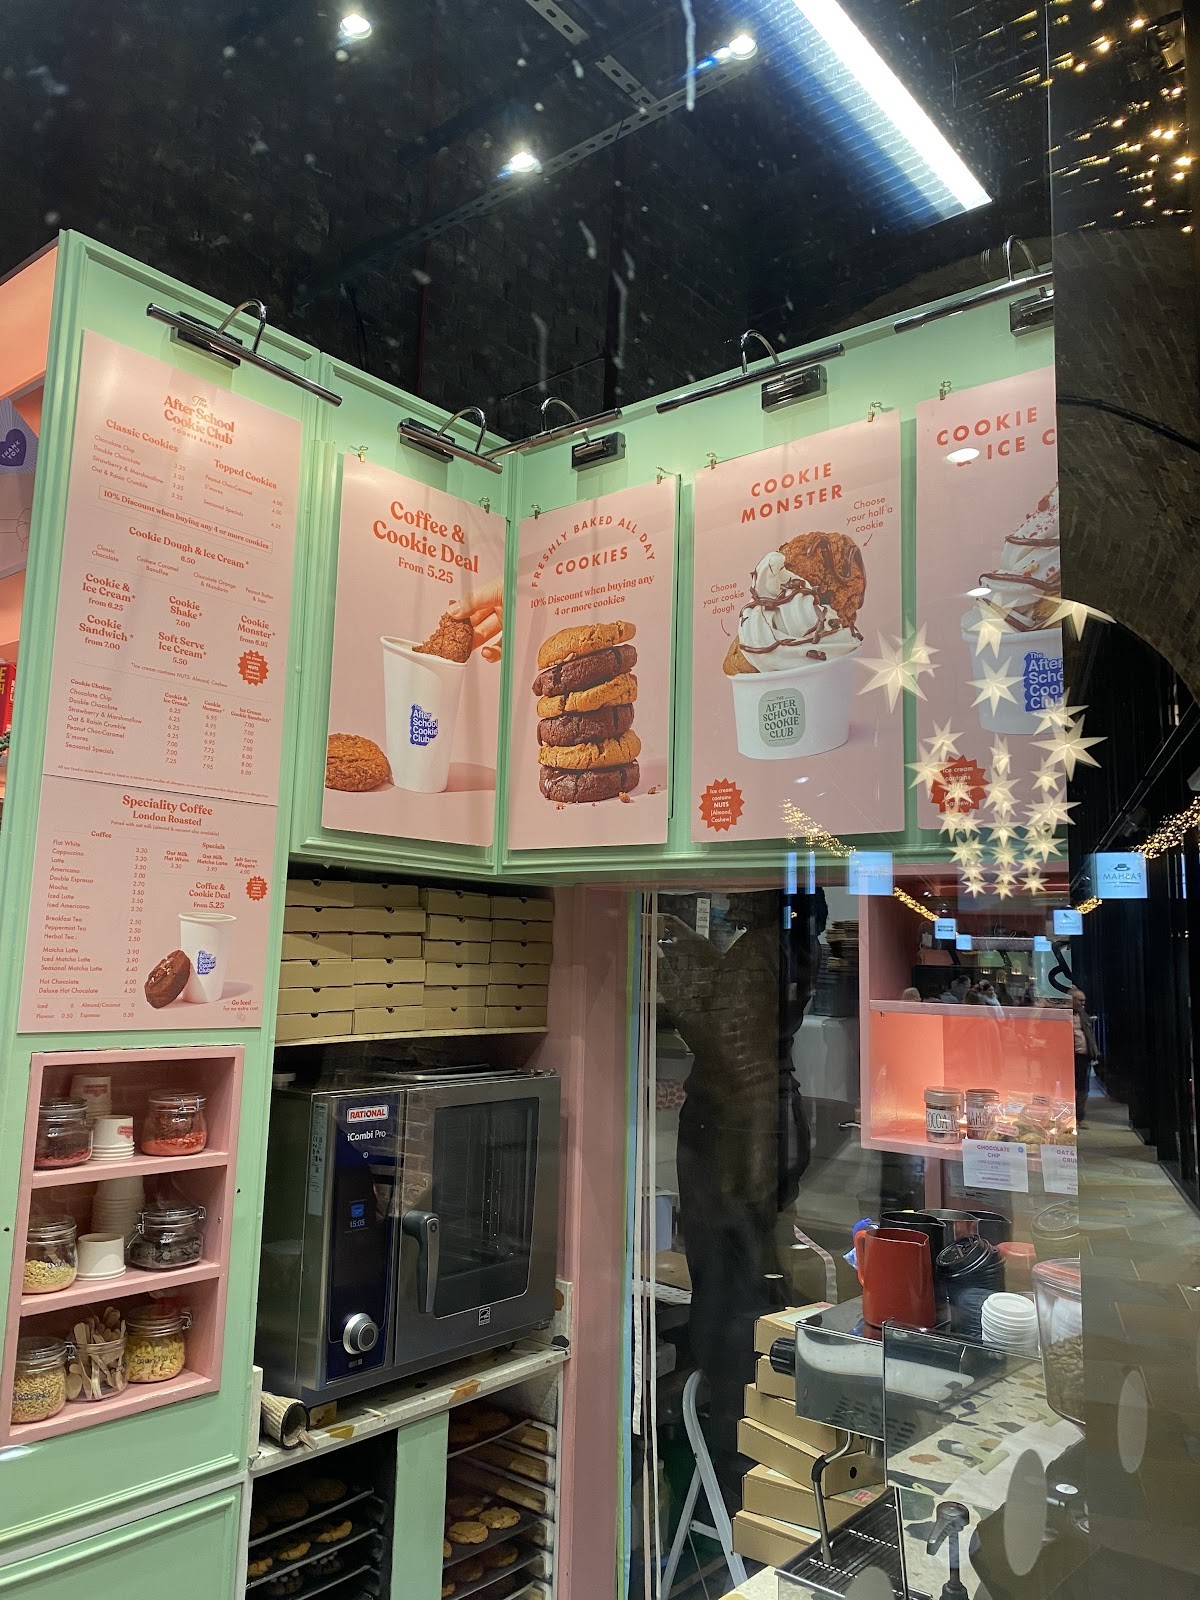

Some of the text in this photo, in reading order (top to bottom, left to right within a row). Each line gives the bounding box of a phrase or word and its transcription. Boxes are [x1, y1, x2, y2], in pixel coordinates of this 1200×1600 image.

[164, 395, 235, 432] After School
[164, 409, 233, 444] Cookie Club
[173, 427, 197, 440] COOKIE
[936, 407, 1037, 446] COOKIE
[94, 434, 121, 449] Chocolate
[106, 419, 179, 453] Classic Cookies
[1, 439, 21, 459] THANK
[8, 447, 20, 460] YOU
[987, 436, 1025, 460] ICE
[92, 455, 122, 470] Strawberry
[214, 459, 277, 490] Topped Cookies
[751, 462, 833, 497] COOKIE
[741, 484, 843, 524] MONSTER
[853, 496, 886, 510] Choose
[104, 489, 120, 501] 10%
[121, 495, 155, 512] Discount
[156, 508, 175, 519] when
[175, 513, 200, 527] buying
[200, 523, 212, 532] any
[227, 531, 245, 542] more
[244, 537, 269, 549] cookies
[390, 500, 466, 545] Coffee &
[846, 506, 894, 526] your half a
[855, 520, 884, 533] cookie
[129, 526, 162, 543] Cookie
[163, 536, 193, 553] Dough
[194, 546, 202, 556] &
[203, 548, 216, 560] Ice
[372, 520, 479, 573] Cookie Deal
[531, 515, 655, 588] FRESHLY BAKED ALL DAY
[555, 546, 628, 575] COOKIES
[398, 556, 454, 584] From 5.25
[82, 582, 97, 594] Ice
[85, 573, 130, 592] Cookie &
[710, 582, 737, 594] Choose
[530, 574, 655, 609] 10% Discount when buying any
[88, 597, 124, 611] from 6.25
[169, 595, 200, 611] Cookie
[554, 594, 626, 616] 4 or more cookies
[703, 590, 745, 608] your cookie
[712, 603, 735, 615] dough
[87, 614, 122, 630] Cookie
[175, 619, 191, 628] 7.00
[240, 615, 269, 629] Cookie
[84, 637, 120, 651] from 7.00
[158, 631, 205, 650] Soft Serve
[158, 641, 172, 652] Ice
[239, 636, 268, 648] from 6.95
[172, 656, 188, 666] 5.50
[69, 688, 112, 702] Chocolate Chip
[68, 697, 118, 711] Double Chocolate
[765, 699, 796, 713] AFTER
[68, 706, 100, 718] Strawberry
[106, 713, 143, 724] Marshmallow
[412, 709, 432, 720] After
[762, 707, 800, 723] SCHOOL
[66, 724, 86, 732] Peanut
[412, 717, 439, 728] School
[764, 716, 800, 731] COOKIE
[412, 726, 439, 736] Cookie
[769, 726, 794, 739] CLUB
[412, 734, 430, 743] Club
[65, 742, 91, 751] Seasonal
[122, 794, 213, 816] Speciality Coffee
[132, 810, 202, 826] London Roasted
[91, 830, 112, 839] Coffee
[50, 866, 81, 874] Americano
[195, 881, 226, 891] Coffee &
[189, 889, 231, 899] Cookie Deal
[60, 902, 90, 910] Americano
[209, 901, 225, 909] 5.25
[44, 924, 76, 932] Peppermint
[350, 1109, 386, 1119] RATIONAL
[347, 1129, 387, 1142] iCombi Pro
[977, 1144, 1010, 1153] CHOCOLATE
